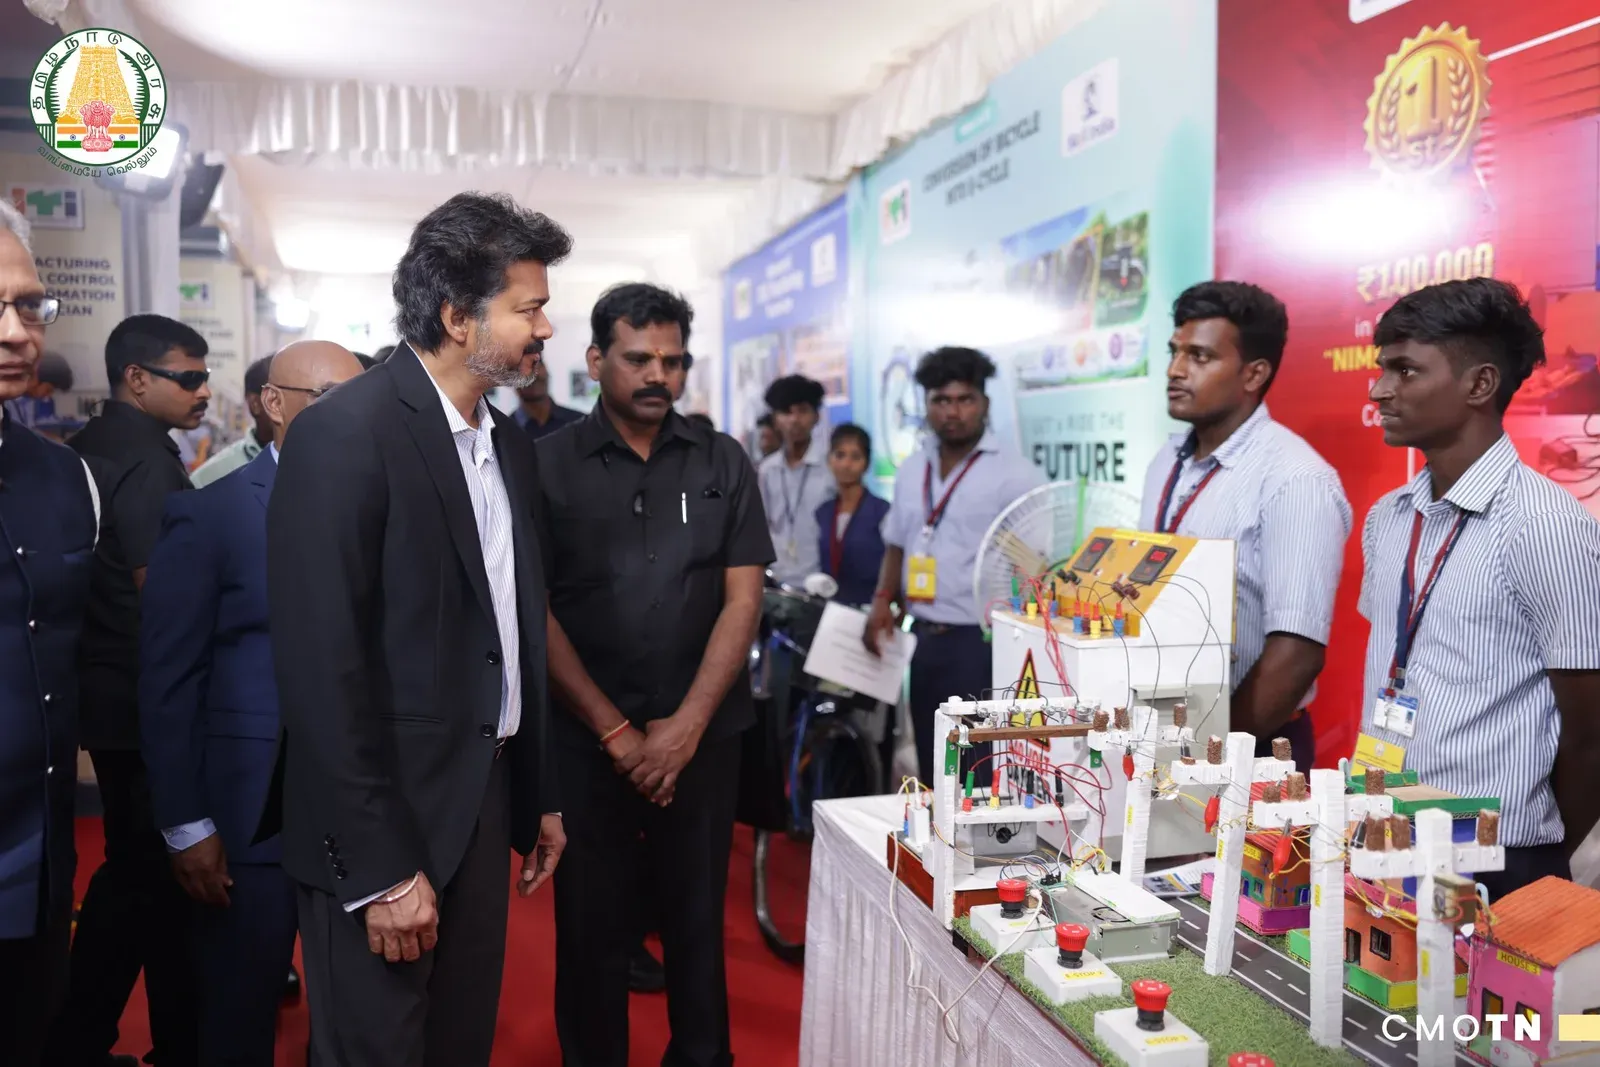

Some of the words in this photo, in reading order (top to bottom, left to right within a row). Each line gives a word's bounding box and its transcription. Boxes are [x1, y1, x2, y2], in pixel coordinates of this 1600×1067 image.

[47, 272, 116, 285] CONTROL
[1033, 442, 1125, 482] FUTURE
[1501, 951, 1530, 971] HOUSE
